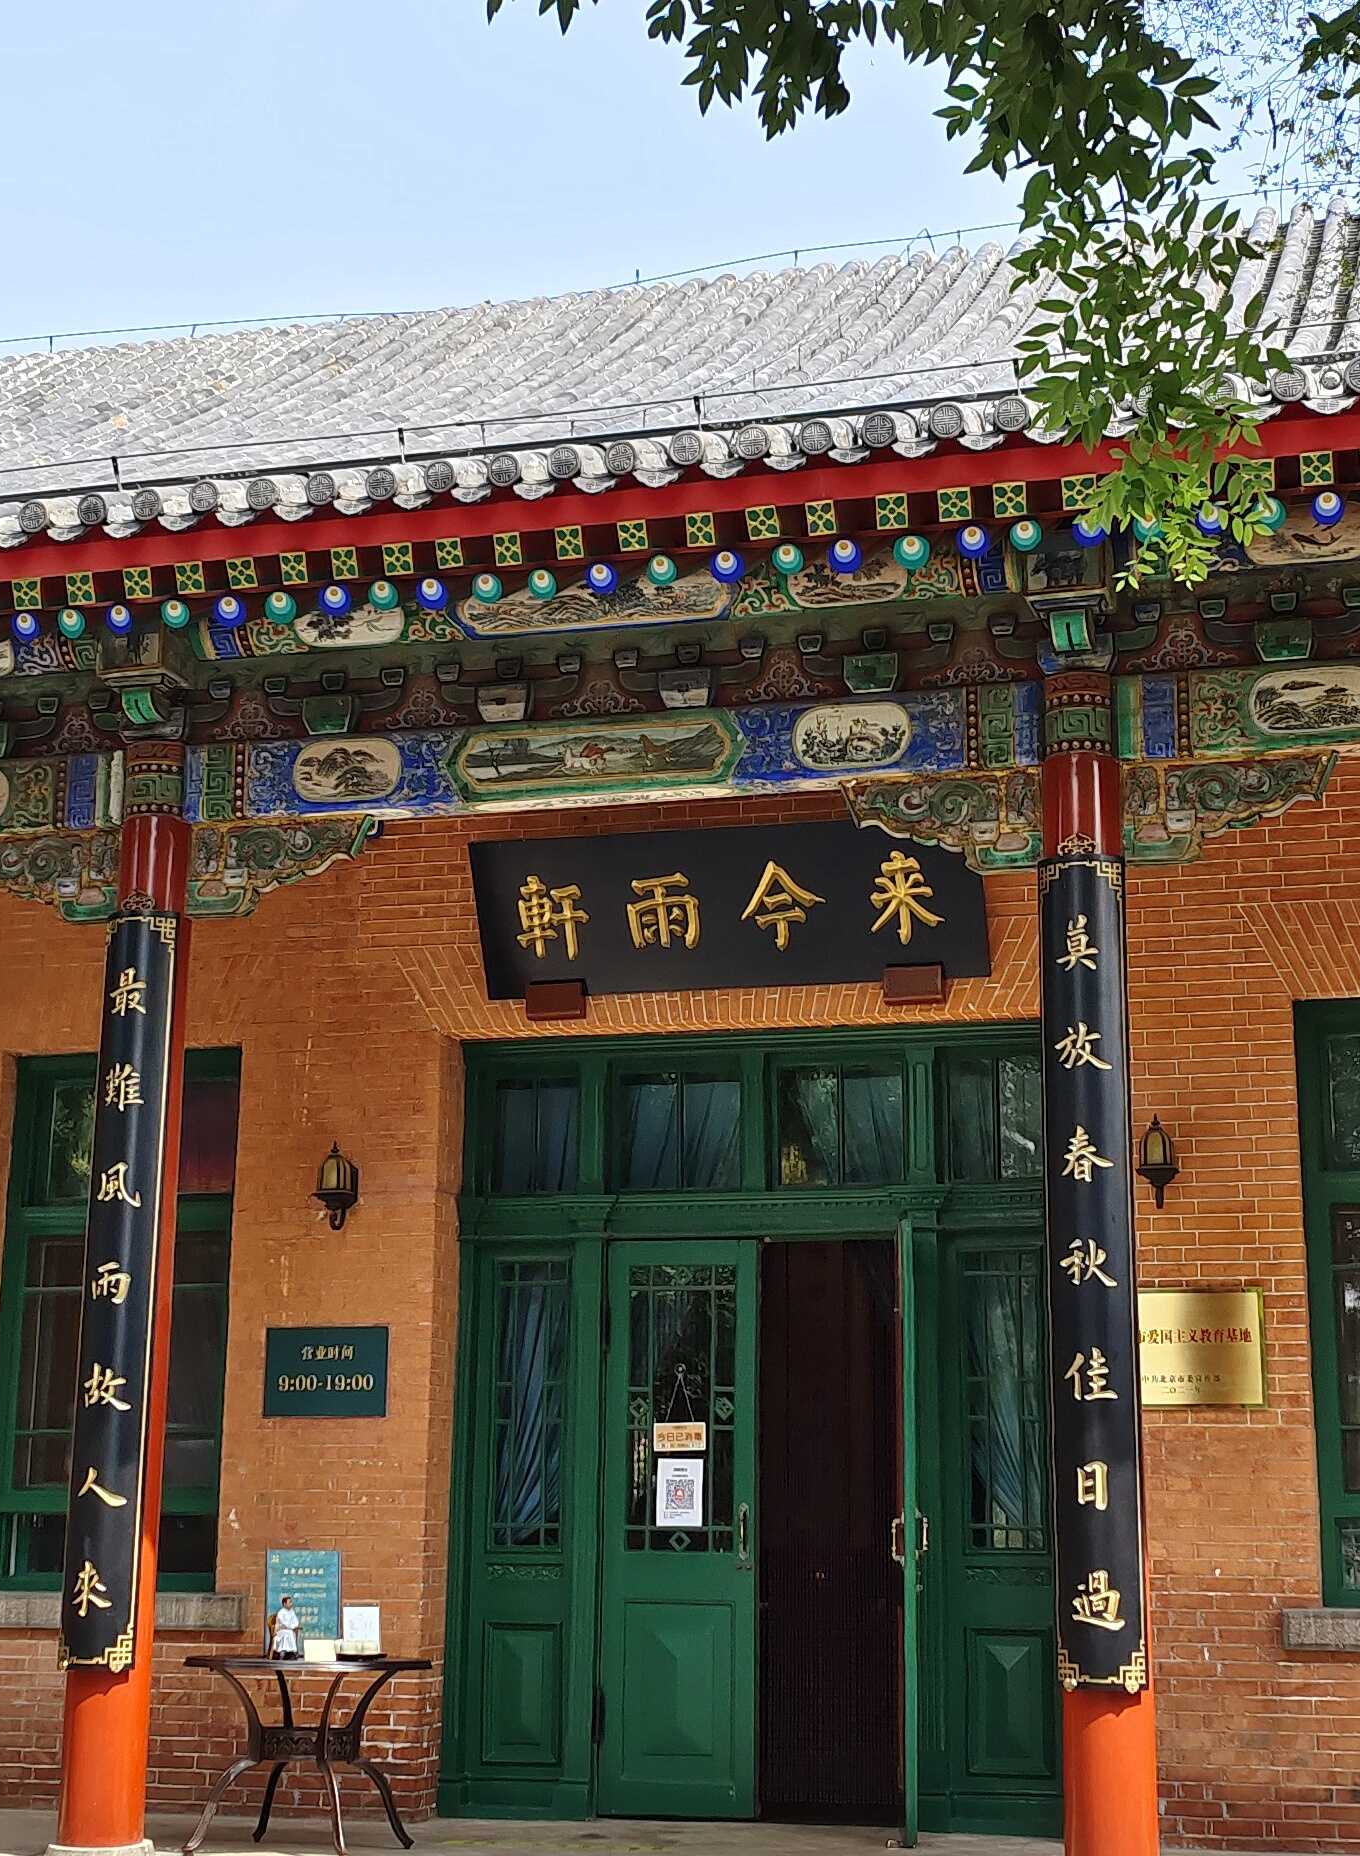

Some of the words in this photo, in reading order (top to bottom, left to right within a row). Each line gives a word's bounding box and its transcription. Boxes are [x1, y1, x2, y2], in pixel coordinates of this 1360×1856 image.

[300, 1345, 355, 1361] 营业时间
[278, 1374, 374, 1392] 9:00-19:00
